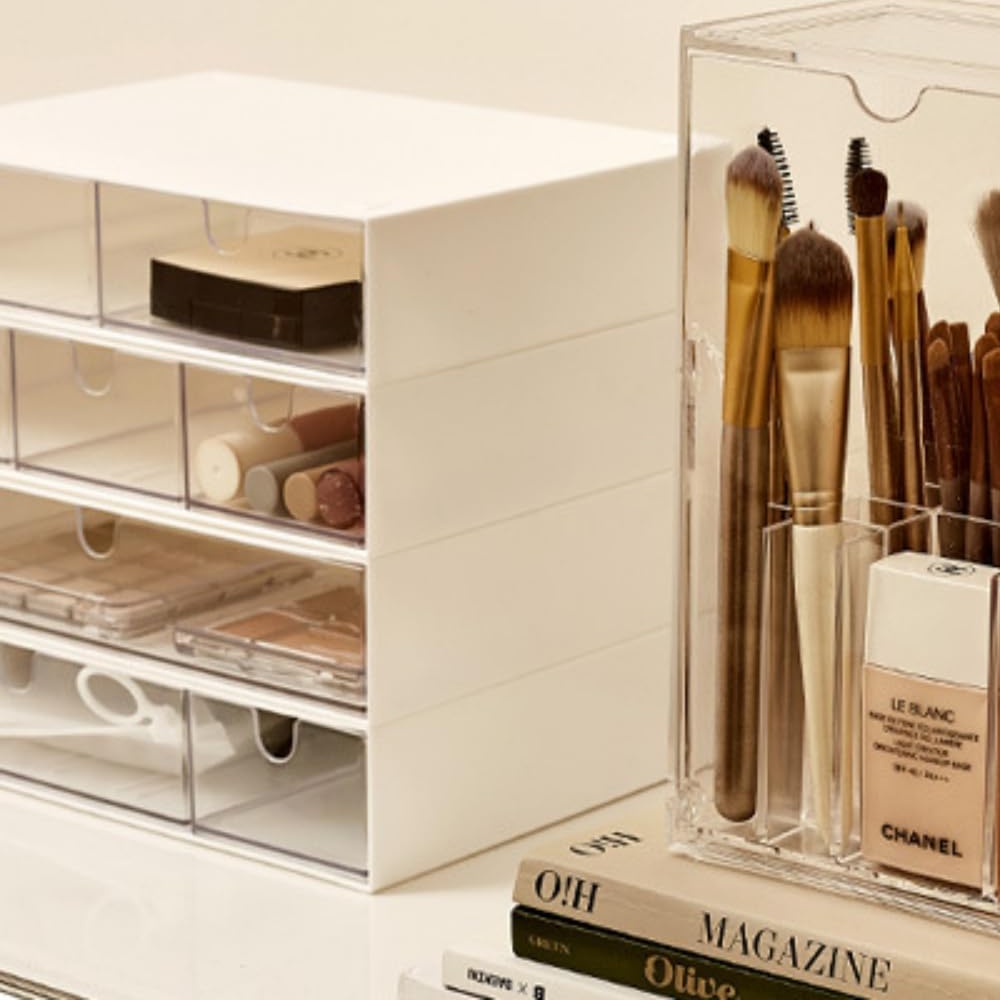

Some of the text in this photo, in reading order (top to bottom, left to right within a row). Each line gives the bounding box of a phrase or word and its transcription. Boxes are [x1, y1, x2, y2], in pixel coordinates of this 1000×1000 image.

[890, 698, 955, 724] LE BLANC
[881, 823, 963, 858] CHANEL
[534, 869, 892, 993] O!H MAGAZINE
[644, 954, 736, 1000] Olive
